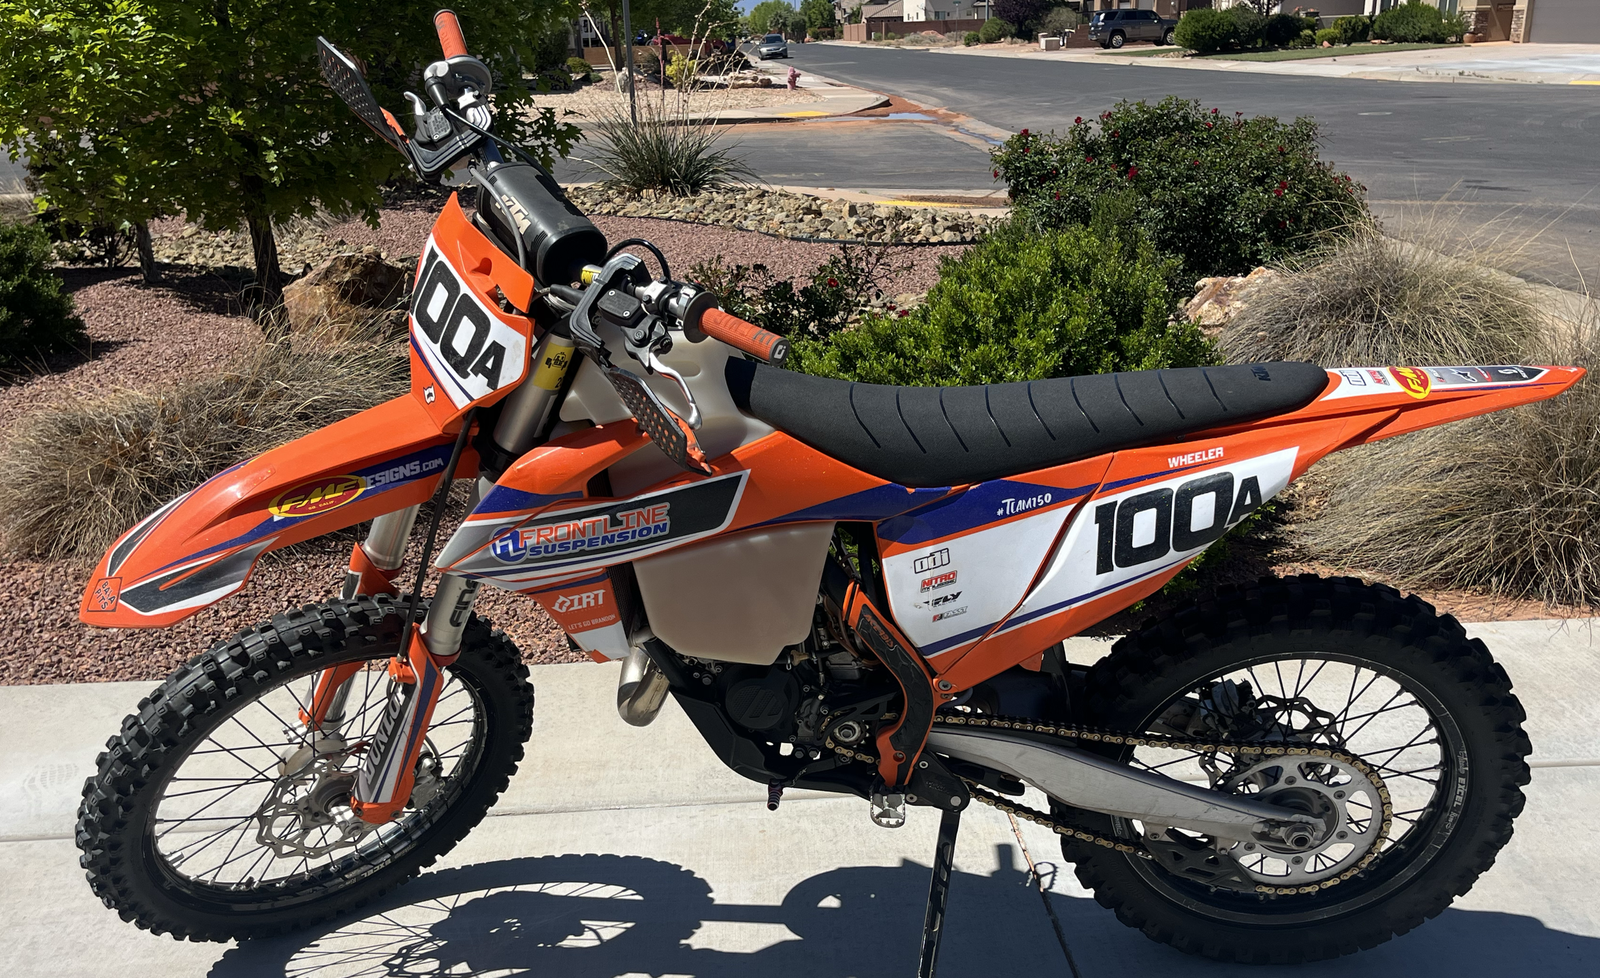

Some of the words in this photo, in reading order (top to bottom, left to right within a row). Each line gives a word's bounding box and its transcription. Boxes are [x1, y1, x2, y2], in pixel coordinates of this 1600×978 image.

[411, 247, 506, 391] 100A
[362, 457, 445, 488] ESIGNS.COM
[1168, 447, 1224, 468] WHEELER
[279, 479, 359, 514] FMF
[519, 504, 668, 547] FRONTLINE
[1095, 471, 1263, 576] 100A
[529, 522, 668, 557] SUSPENSION
[922, 571, 957, 588] NITRO
[95, 588, 109, 610] PITS
[551, 589, 606, 613] DIRT
[591, 614, 616, 626] BRANDON
[1453, 777, 1467, 808] EXCEL
